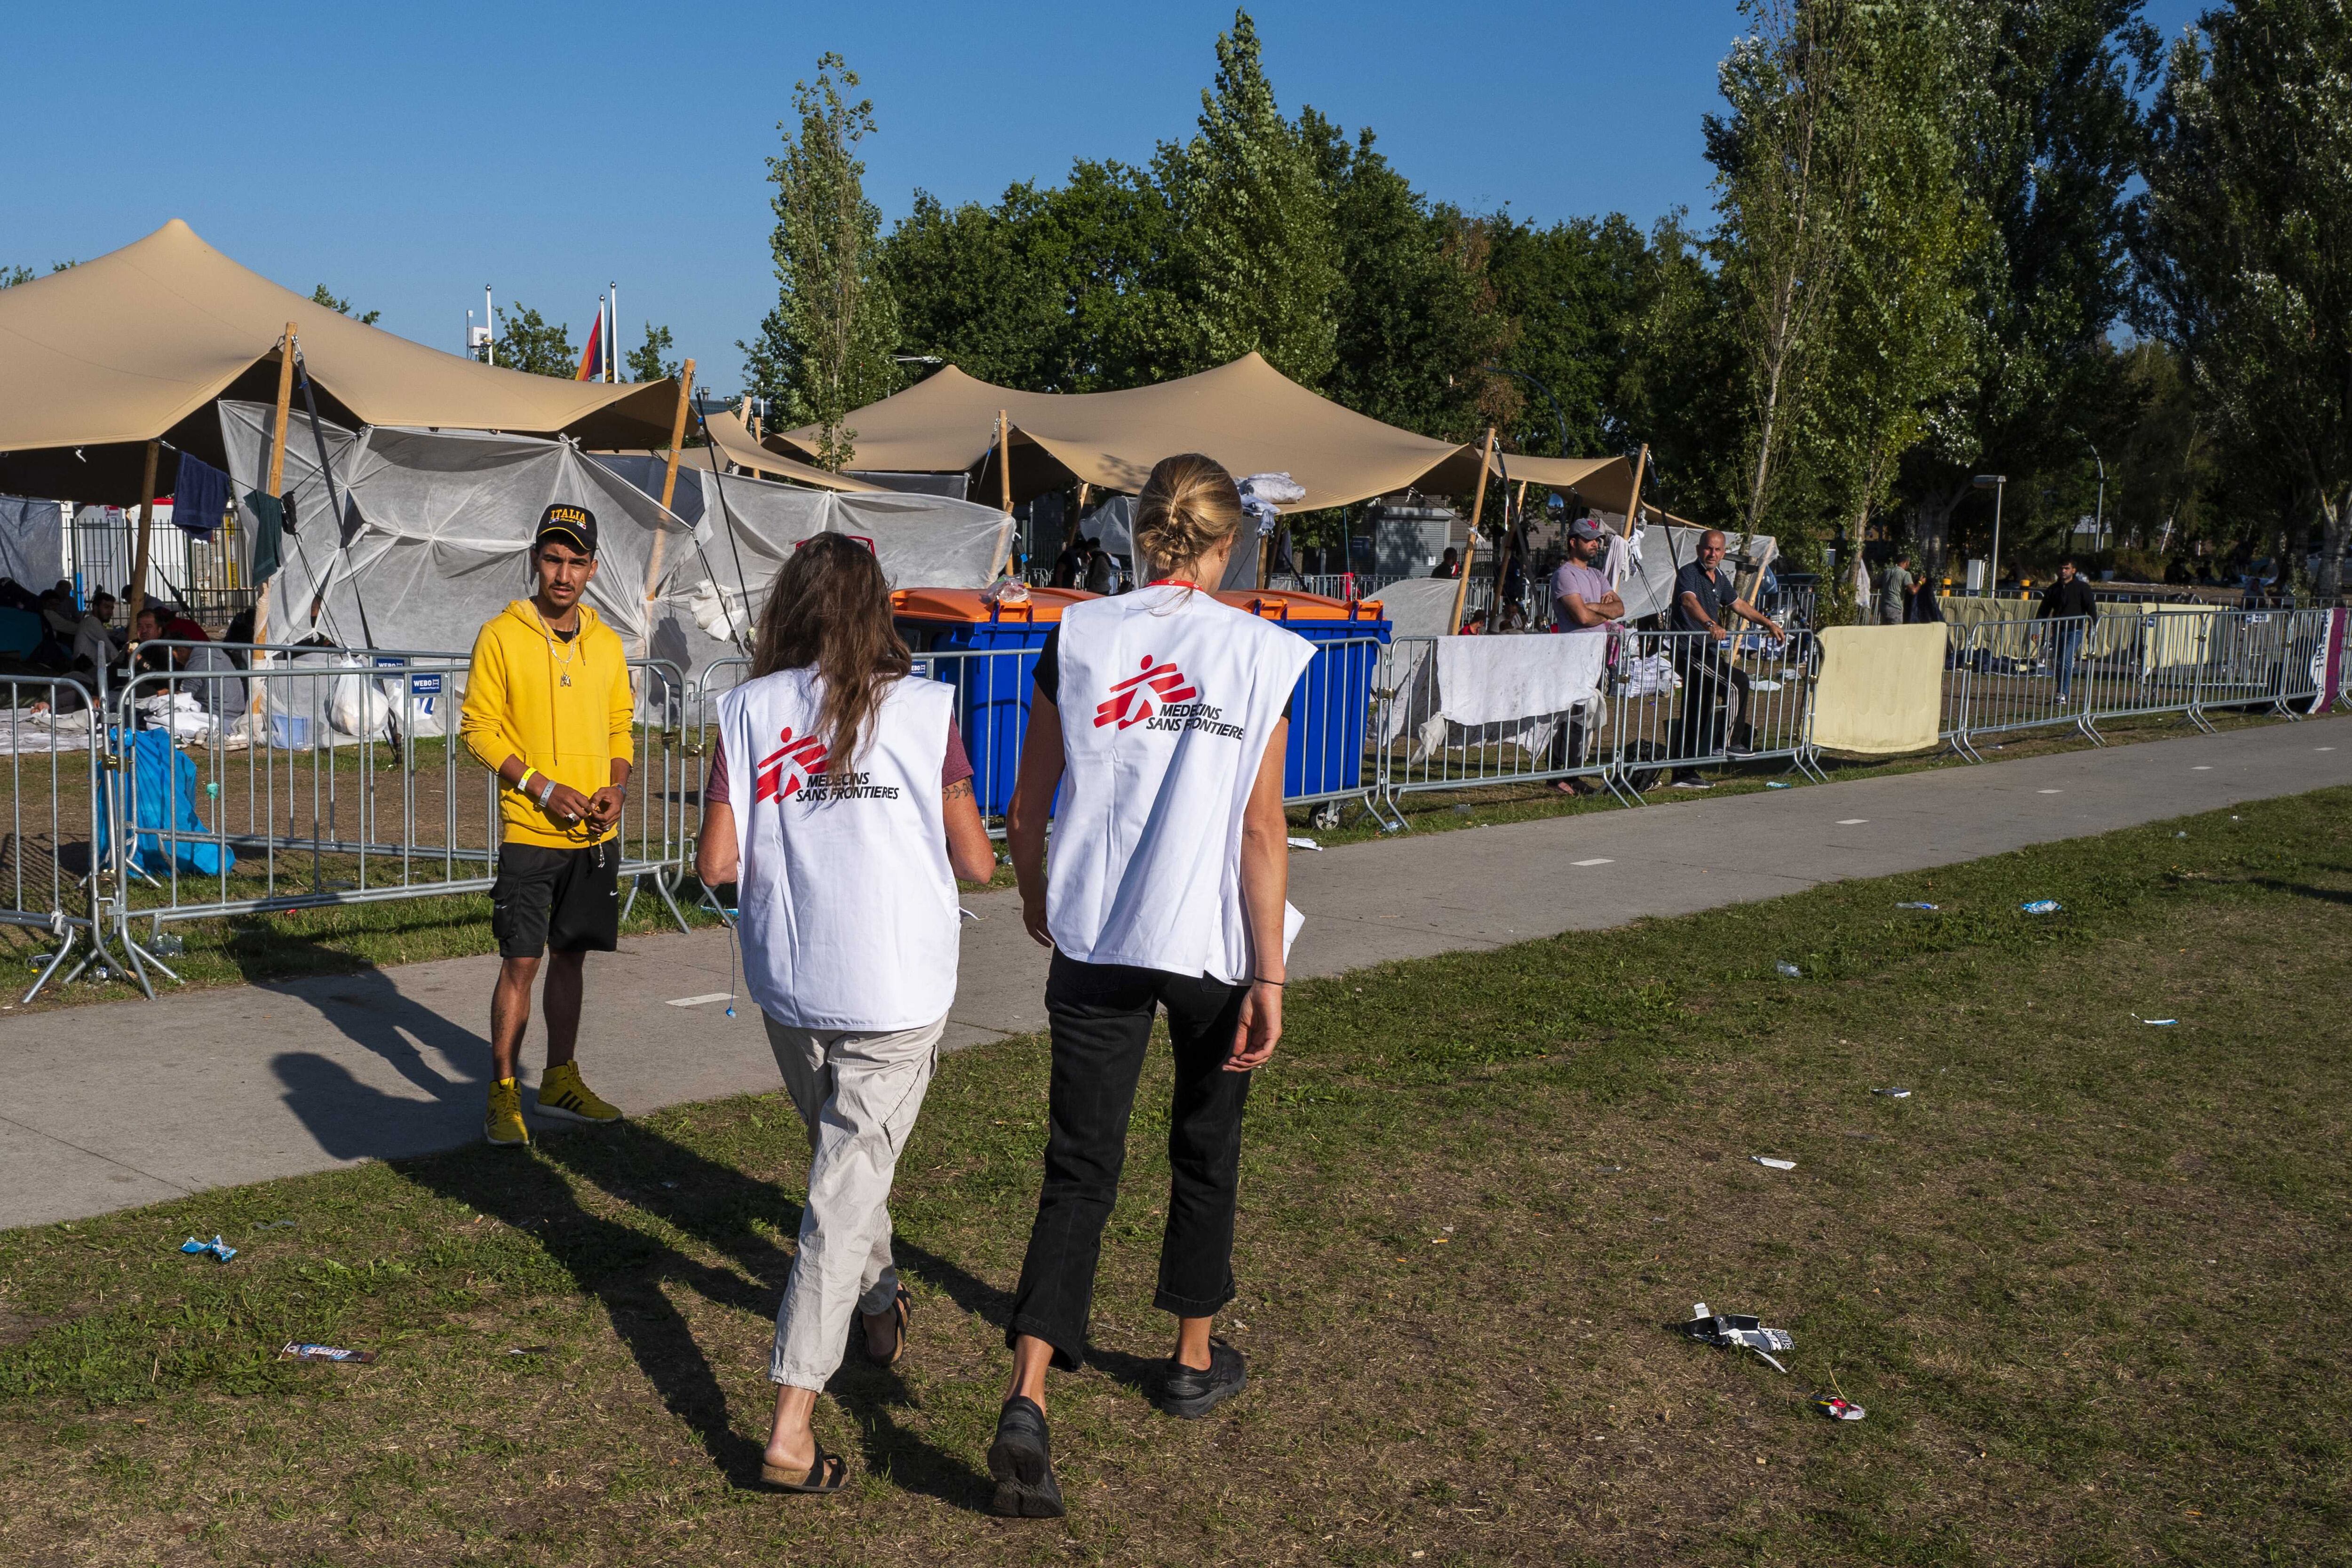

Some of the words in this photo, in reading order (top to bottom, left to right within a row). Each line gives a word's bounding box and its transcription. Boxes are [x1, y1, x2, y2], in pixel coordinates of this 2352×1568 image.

[550, 509, 586, 524] ITALIA
[1146, 717, 1182, 732] SANS
[796, 788, 827, 802] SANS
[830, 786, 899, 800] FRONTIERES
